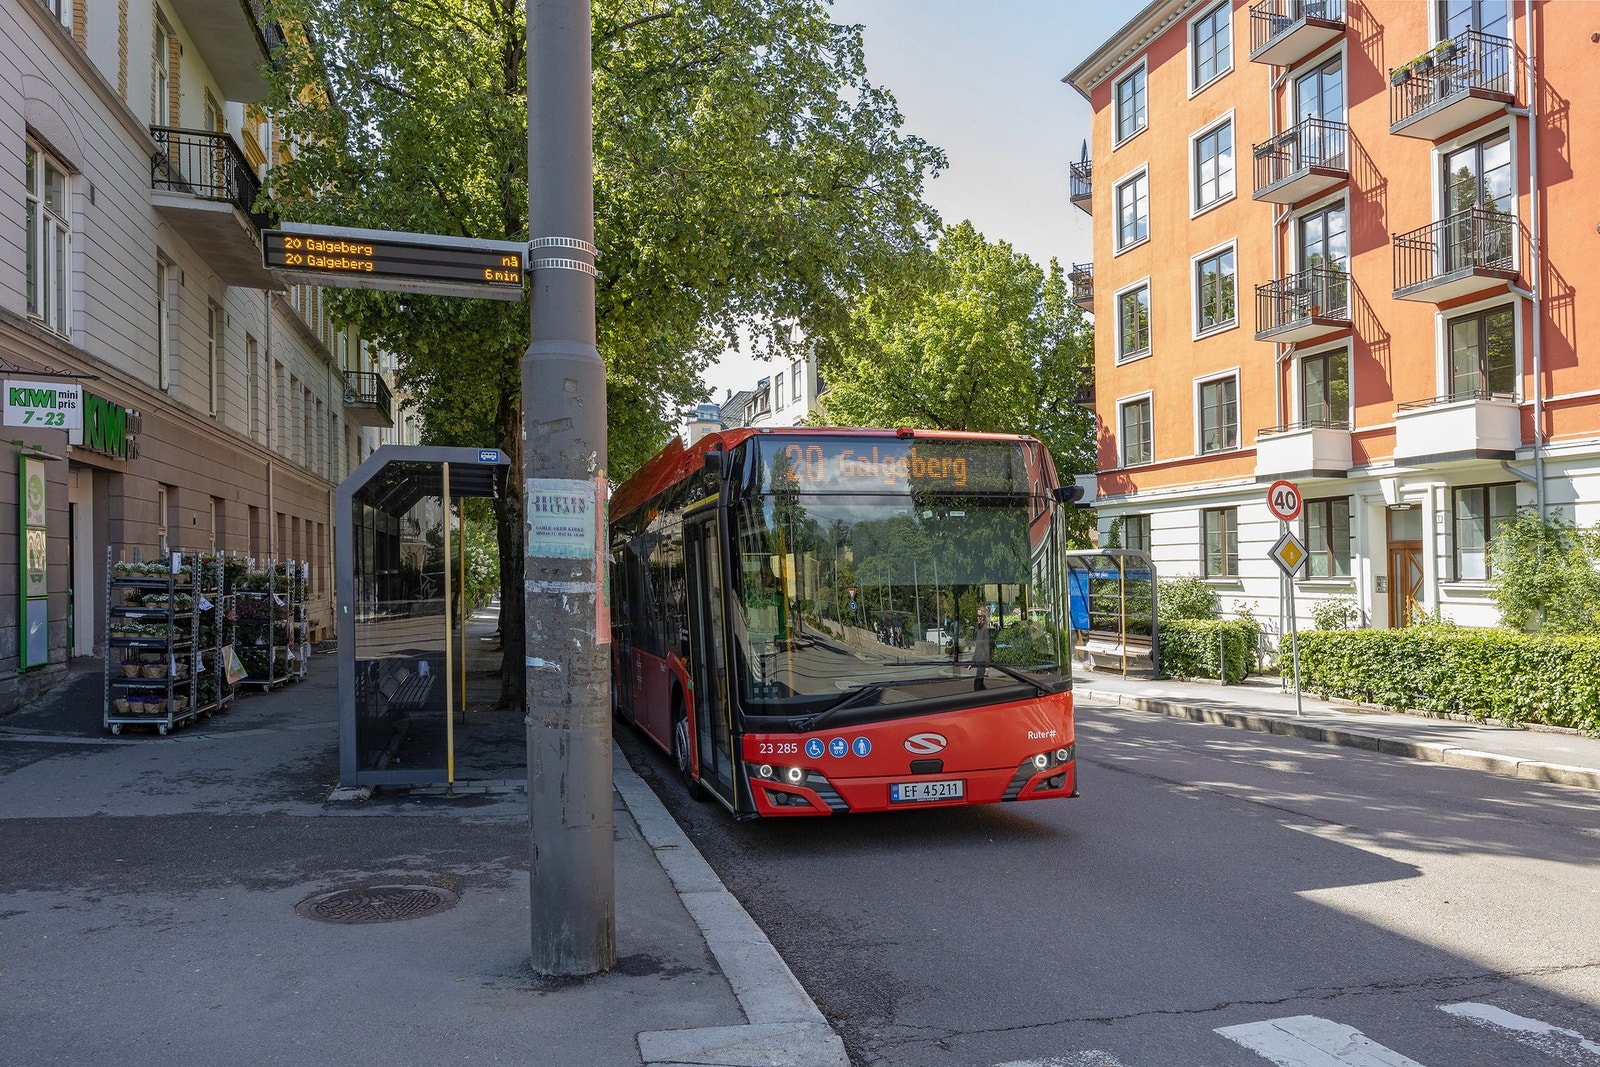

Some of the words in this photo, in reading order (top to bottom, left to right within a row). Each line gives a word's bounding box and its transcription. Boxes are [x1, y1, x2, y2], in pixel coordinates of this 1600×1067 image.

[284, 237, 301, 249] 20
[306, 239, 373, 256] Galgeberg
[285, 253, 302, 265] 20
[307, 255, 373, 271] Galgeberg
[502, 256, 518, 267] nå
[9, 387, 57, 409] KIWI
[58, 390, 78, 400] mini
[58, 400, 76, 410] pris
[84, 391, 126, 457] KIWI
[785, 444, 825, 483] 20
[838, 446, 967, 487] Galgeberg
[536, 496, 585, 505] BRITTEN
[1274, 490, 1296, 510] 40
[536, 504, 585, 513] BRITAIN
[759, 742, 774, 754] 23
[777, 742, 798, 754] 285
[904, 785, 917, 798] EF
[923, 783, 958, 797] 45211
